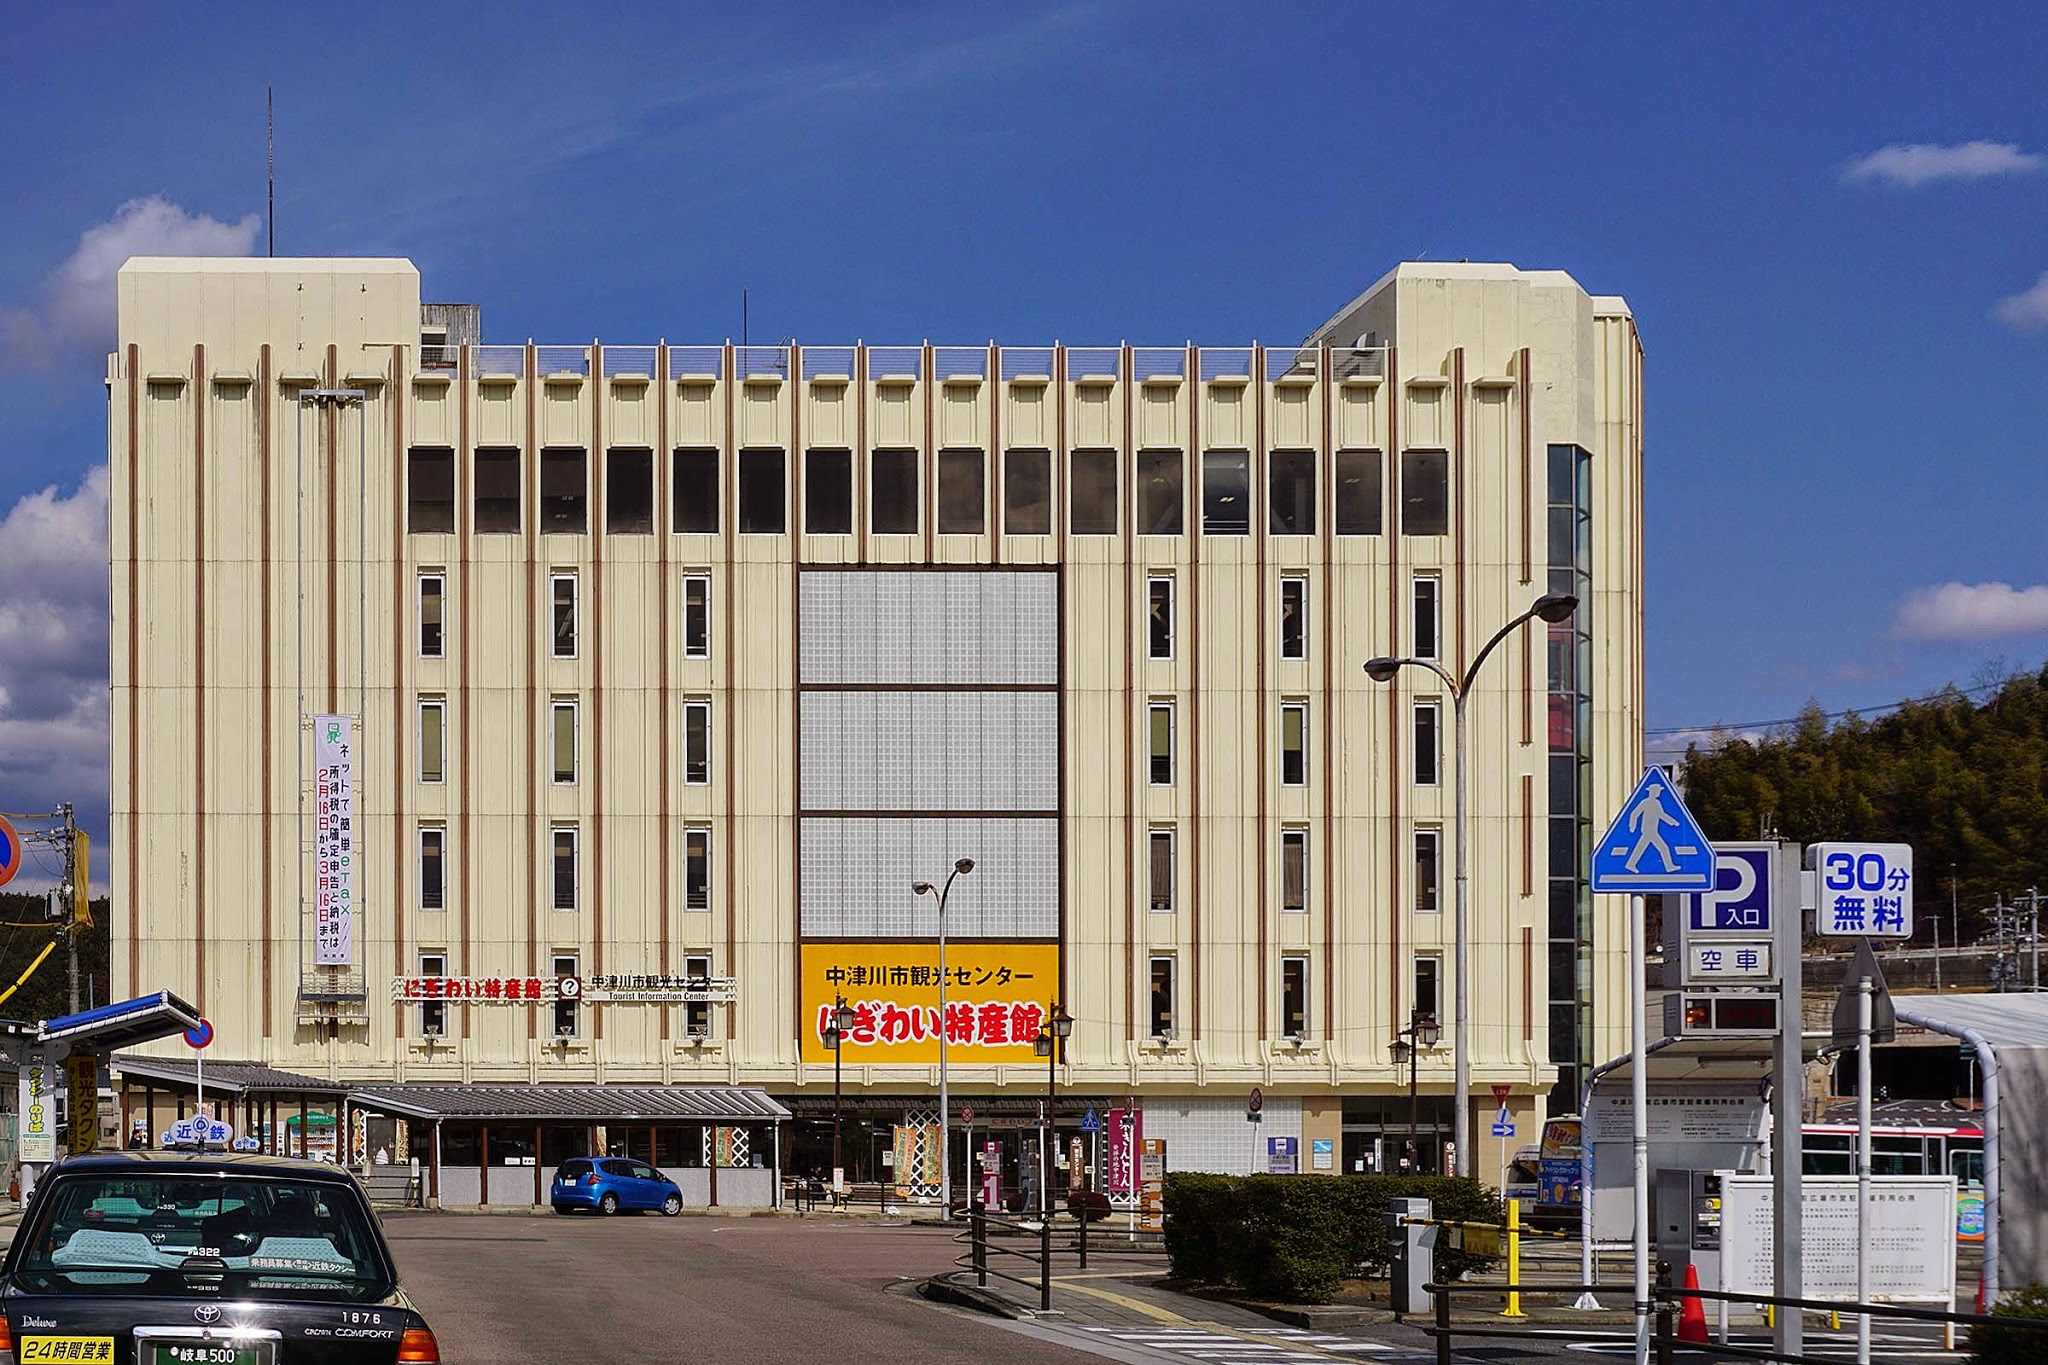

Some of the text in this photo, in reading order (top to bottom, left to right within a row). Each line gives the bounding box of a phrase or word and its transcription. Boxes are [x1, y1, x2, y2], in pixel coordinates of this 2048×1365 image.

[319, 769, 329, 949] 2月16日から3月16日まで
[329, 765, 339, 948] 所得税の確定申告と納税は
[1826, 853, 1910, 892] 30分
[1701, 856, 1756, 927] P
[1725, 908, 1760, 926] 入口
[1833, 895, 1904, 932] 無料
[1701, 949, 1758, 972] 空車
[591, 974, 726, 989] 中津川市観光センター
[825, 965, 1034, 987] 中津川市観光センター
[405, 977, 542, 999] にぎわい特産館
[608, 992, 709, 1001] Tourist Information Center
[818, 1002, 1044, 1044] にぎわい特産館
[29, 1068, 44, 1133] タクシーのりば
[177, 1124, 225, 1140] 近鉄
[21, 1314, 58, 1328] Deluxe
[342, 1311, 381, 1324] 1876
[334, 1328, 394, 1338] COMFORT
[23, 1340, 112, 1360] 24時間営業
[180, 1348, 235, 1363] 岐阜 500
